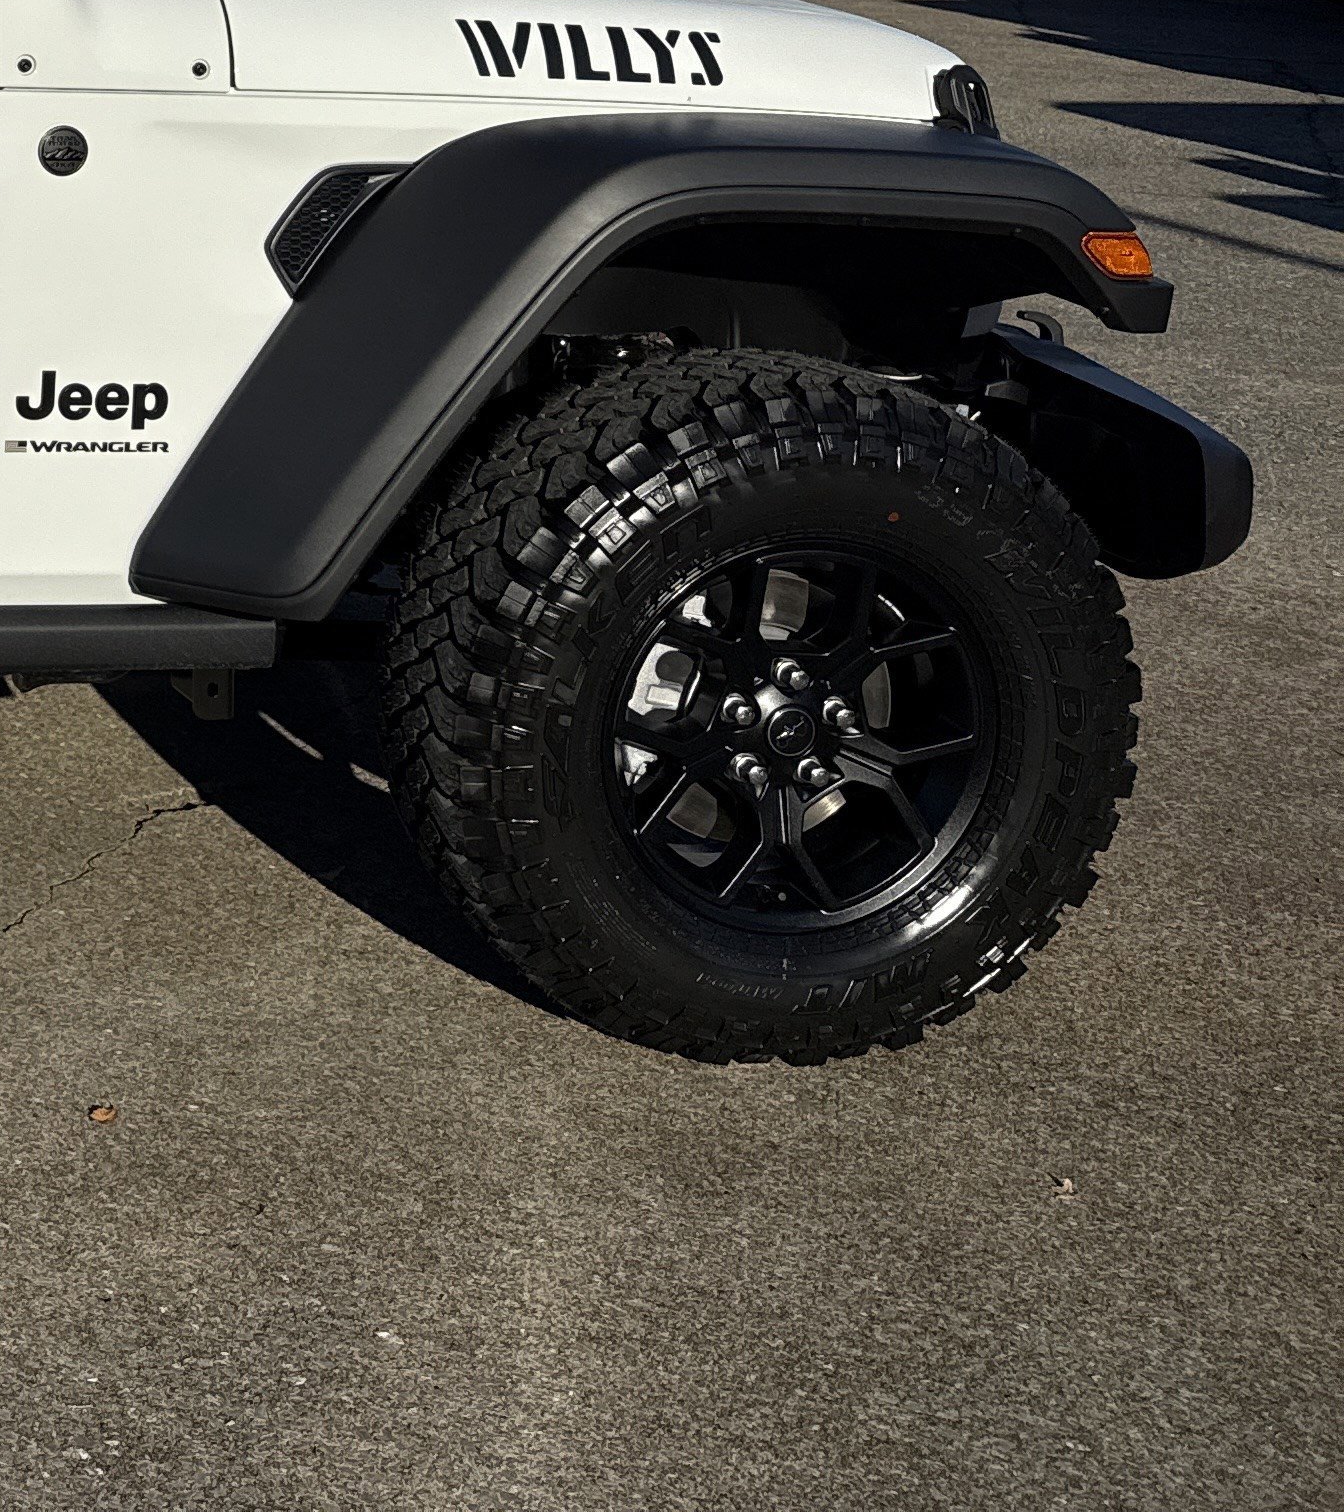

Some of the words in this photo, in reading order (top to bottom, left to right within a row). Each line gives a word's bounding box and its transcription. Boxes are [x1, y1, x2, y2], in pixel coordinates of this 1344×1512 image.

[454, 18, 724, 86] WILLYS
[15, 370, 169, 430] Jeep
[29, 440, 170, 453] WRANGLER
